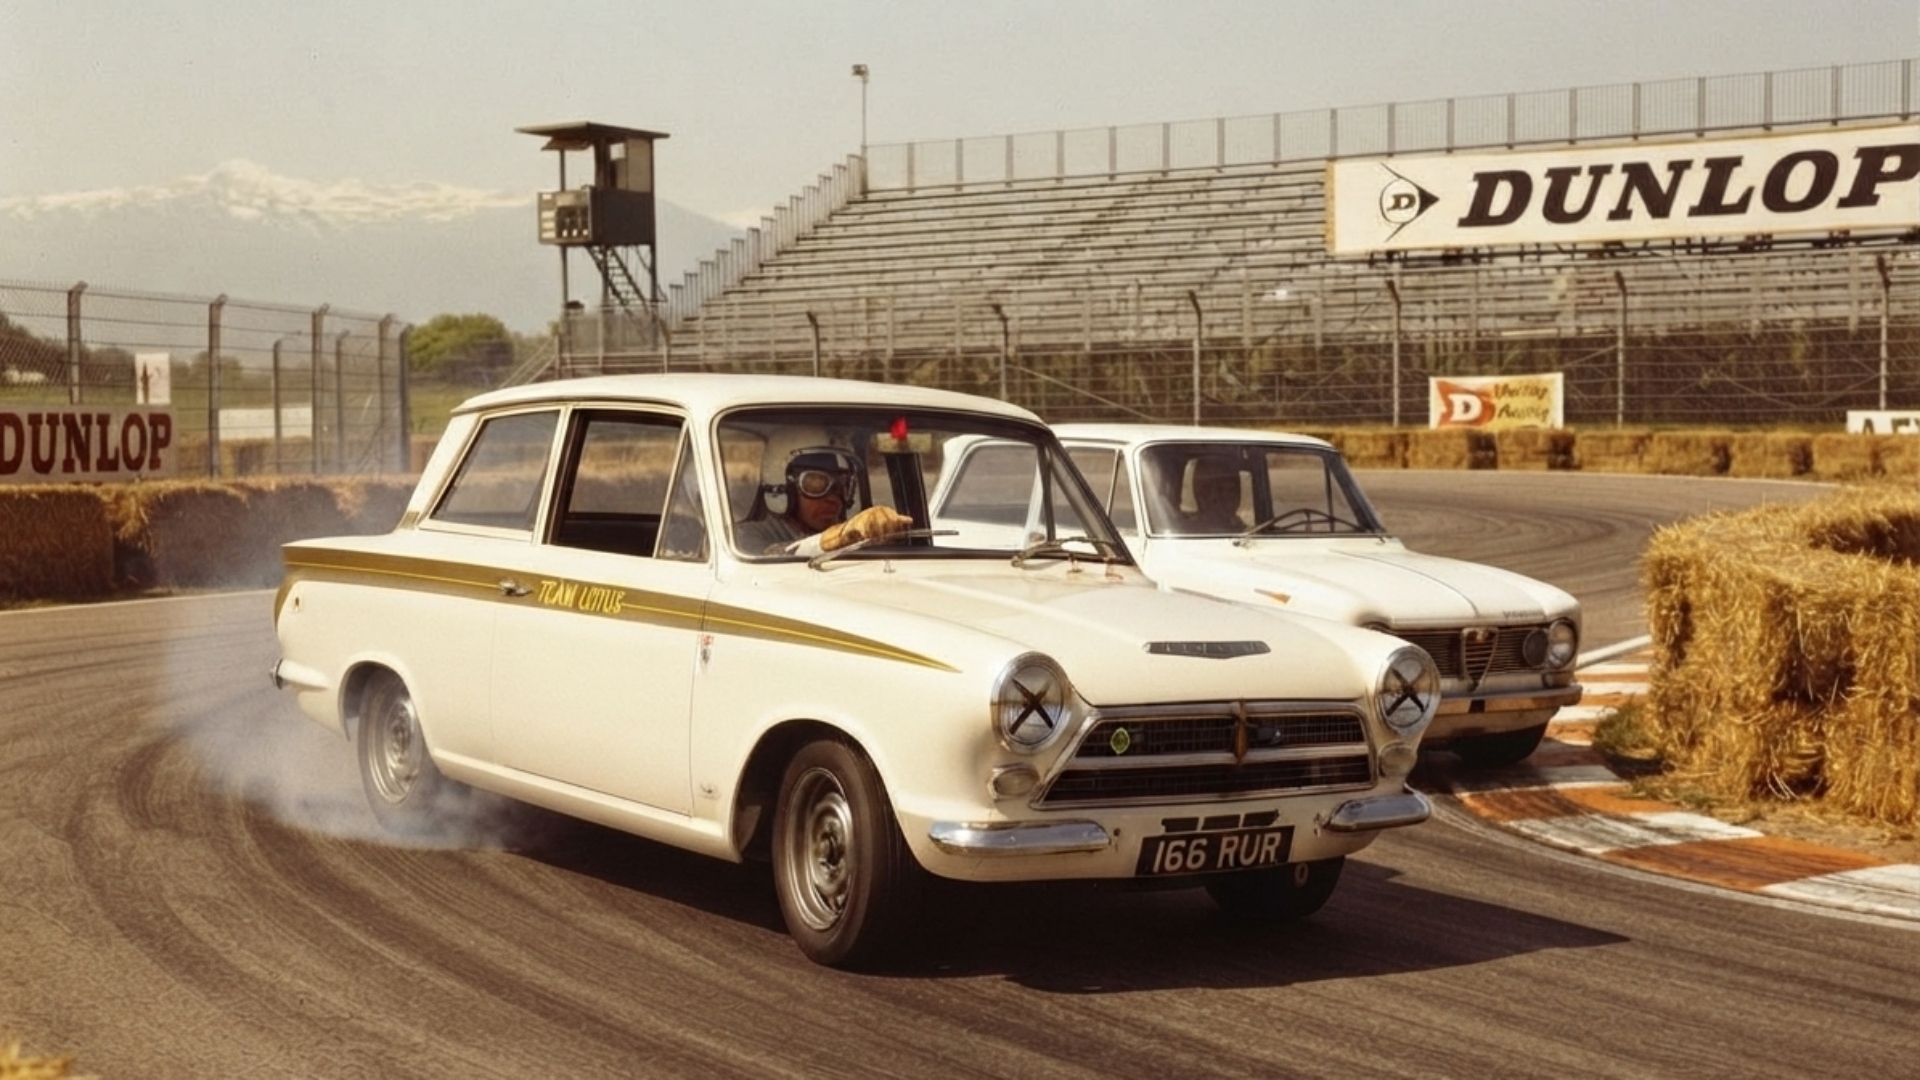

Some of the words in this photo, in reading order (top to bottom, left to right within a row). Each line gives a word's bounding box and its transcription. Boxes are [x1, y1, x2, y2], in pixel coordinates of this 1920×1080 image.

[1386, 193, 1416, 211] D
[1457, 143, 1920, 229] DUNLOP
[0, 412, 172, 475] DUNLOP
[1152, 838, 1207, 873] 166
[1216, 832, 1281, 869] RUR
